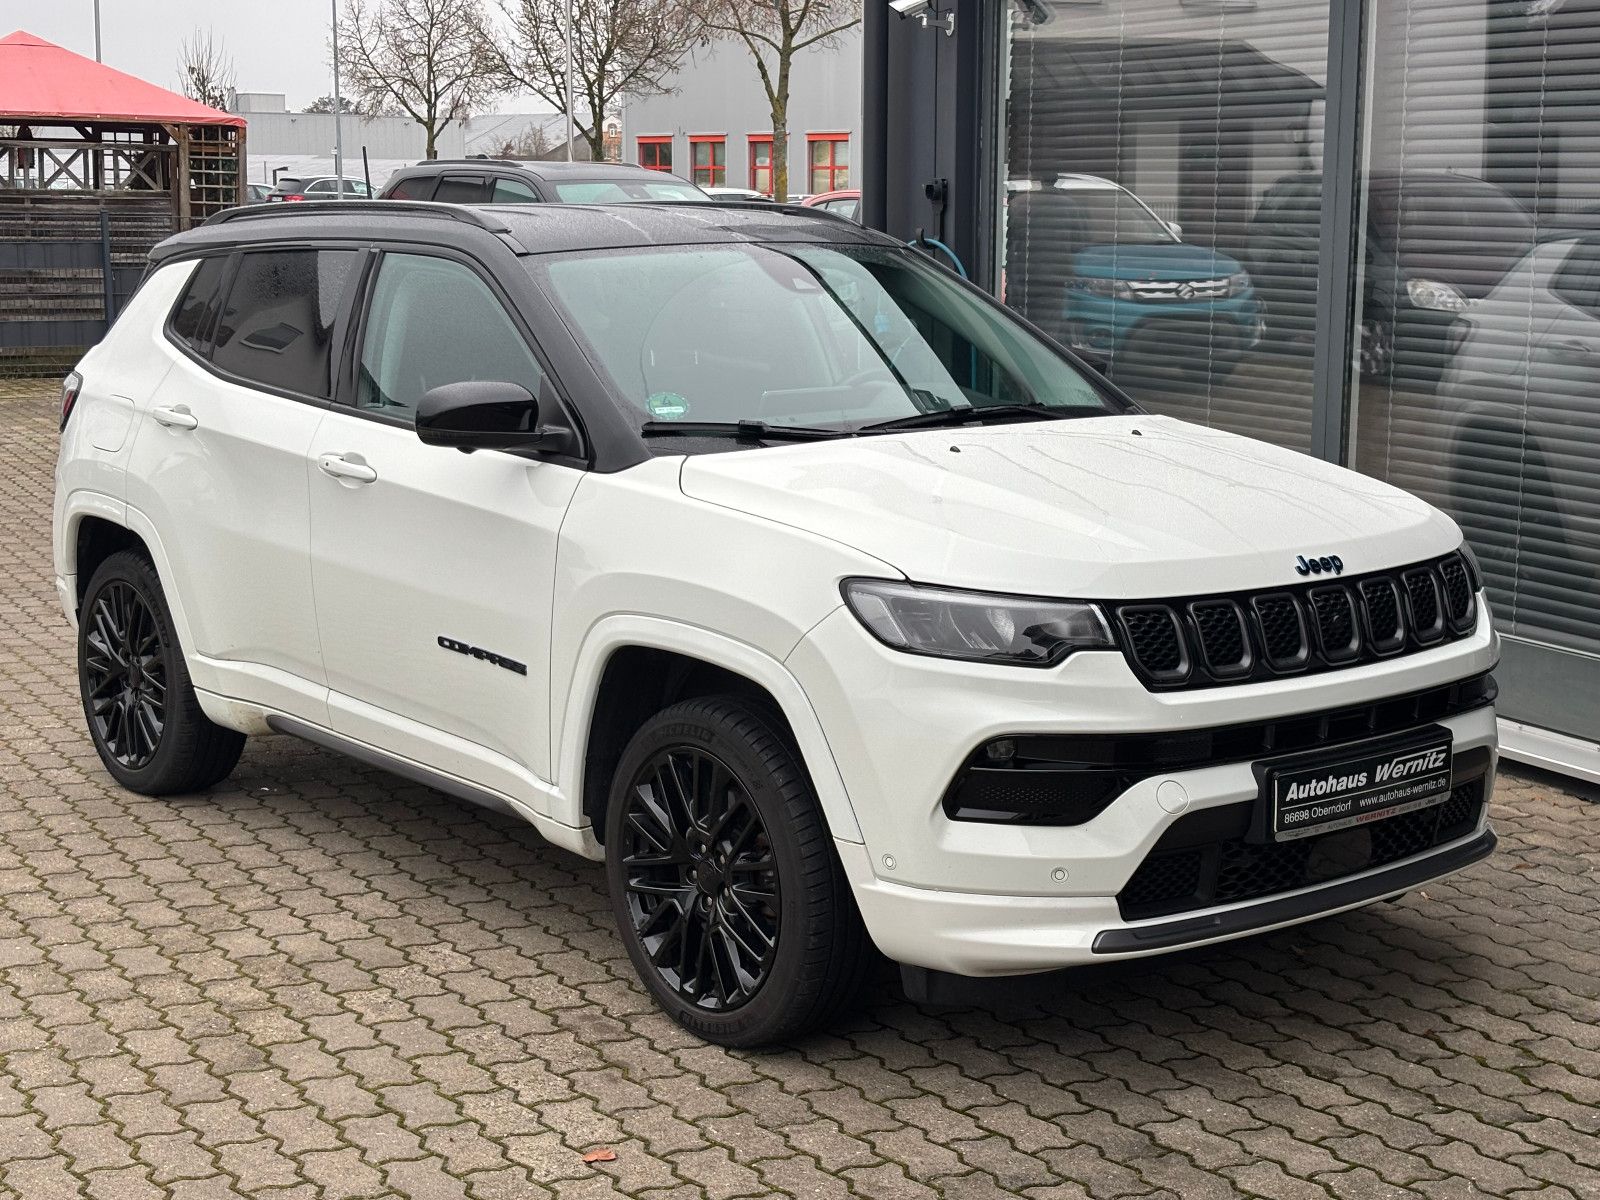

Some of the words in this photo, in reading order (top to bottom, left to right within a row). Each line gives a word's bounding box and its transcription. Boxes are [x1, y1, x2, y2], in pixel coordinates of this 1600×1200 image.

[1295, 555, 1343, 576] Jeep
[437, 636, 527, 676] COMPASS
[1286, 770, 1367, 801] Autohaus
[1375, 746, 1447, 783] Wernitz
[1284, 809, 1310, 824] 86698
[1311, 800, 1352, 819] Oberndorf
[1359, 778, 1447, 808] www.autohaus-wernitz.de
[1356, 807, 1398, 824] WERNITZ
